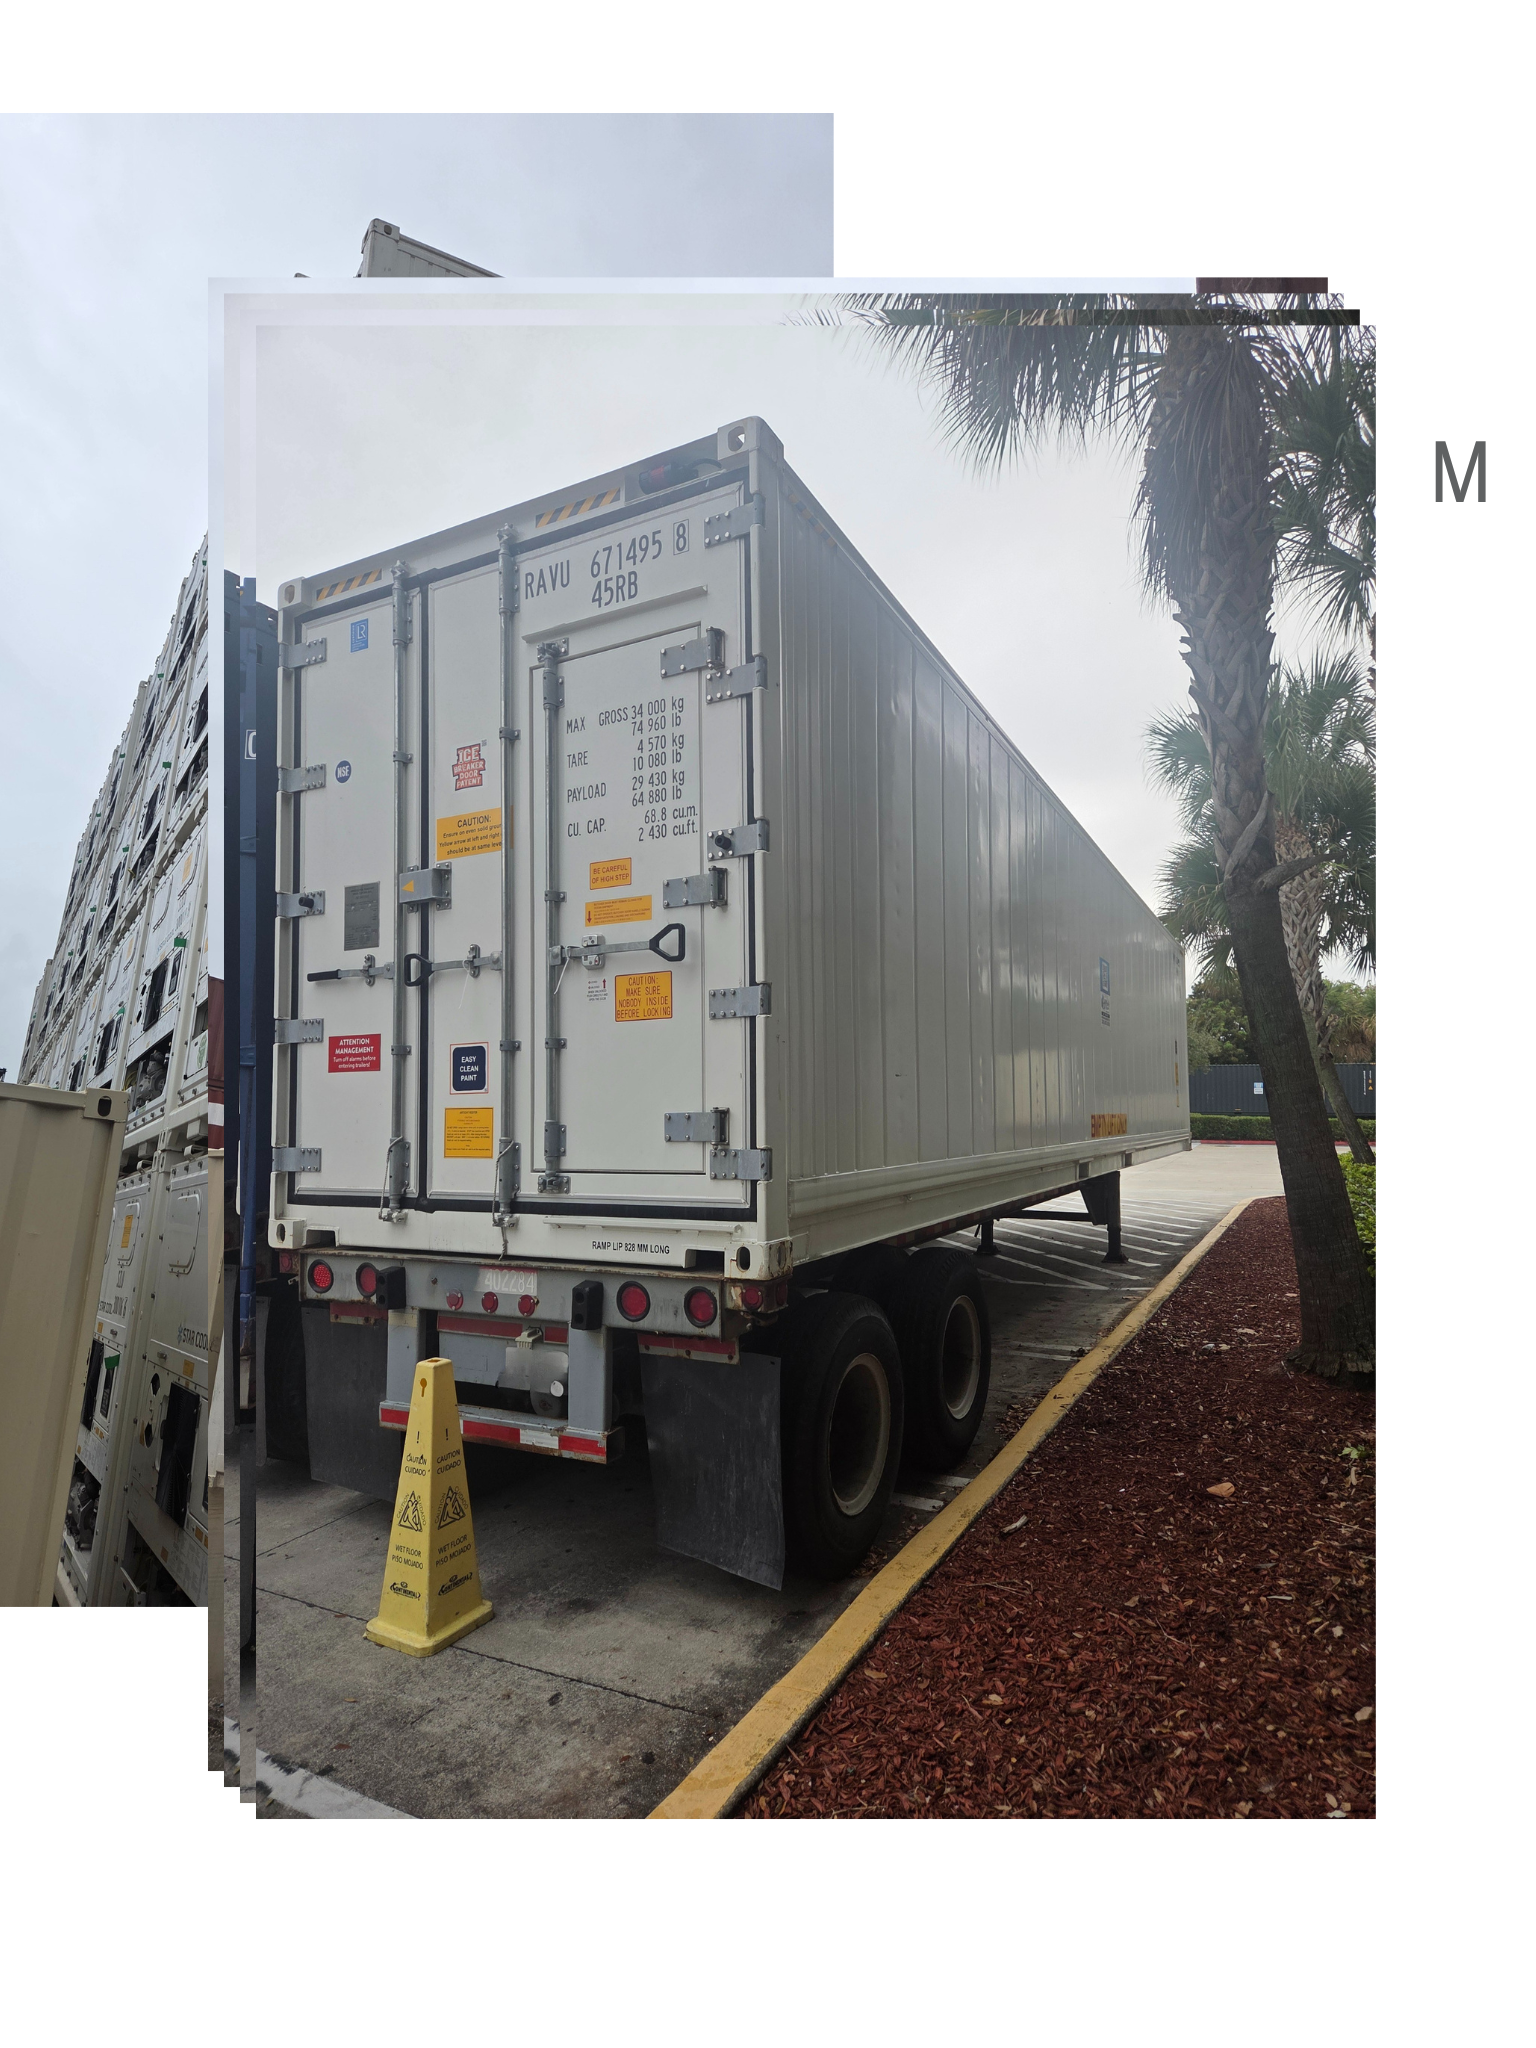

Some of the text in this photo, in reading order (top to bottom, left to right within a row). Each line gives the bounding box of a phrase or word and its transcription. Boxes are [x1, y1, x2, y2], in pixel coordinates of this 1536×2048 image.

[525, 523, 686, 599] RAVU 671495 8
[592, 571, 638, 608] 45RB
[566, 696, 684, 734] MAX GROSS 34 000 kg
[631, 712, 682, 736] 74 960 lb
[637, 732, 685, 754] 4 570 kg
[459, 746, 480, 765] ICE
[567, 750, 589, 769] TARE
[633, 748, 682, 772] 10 080 lb
[453, 761, 484, 774] BREAKER
[459, 769, 479, 780] DOOR
[456, 776, 482, 789] PATENT
[632, 769, 685, 791] 29 430 kg
[567, 782, 607, 803] PAYLOAD
[632, 785, 682, 807] 64 880 lb
[457, 814, 492, 828] CAUTION:
[644, 805, 698, 824] 68.8 cu.m.
[567, 817, 607, 838] CU. CAP.
[638, 819, 698, 842] 2 430 cu.ft.
[489, 832, 500, 840] right
[447, 847, 464, 856] should
[601, 864, 628, 874] CAREFUL
[600, 875, 614, 883] HIGH
[615, 872, 630, 881] STEP
[625, 985, 661, 997] MAKE SURE
[618, 995, 669, 1008] NOBODY INSIDE
[616, 1006, 671, 1019] BEFORE LOCKING
[339, 1038, 370, 1046] ATTENTION
[335, 1046, 374, 1055] MANAGEMENT
[461, 1055, 476, 1063] EASY
[459, 1065, 479, 1073] CLEAN
[460, 1074, 477, 1082] PAINT
[592, 1240, 670, 1254] RAMP LIP 828 MM LONG
[484, 1269, 535, 1293] 402284
[406, 1453, 427, 1466] CAUTION
[436, 1448, 460, 1464] CAUTION
[404, 1465, 426, 1476] CUIDADO
[436, 1459, 461, 1475] CUIDADO
[395, 1544, 422, 1558] WET FLOOR
[438, 1534, 468, 1555] WET FLOOR
[391, 1554, 423, 1570] PISO MOJADO
[435, 1543, 472, 1568] PISO MOJADO
